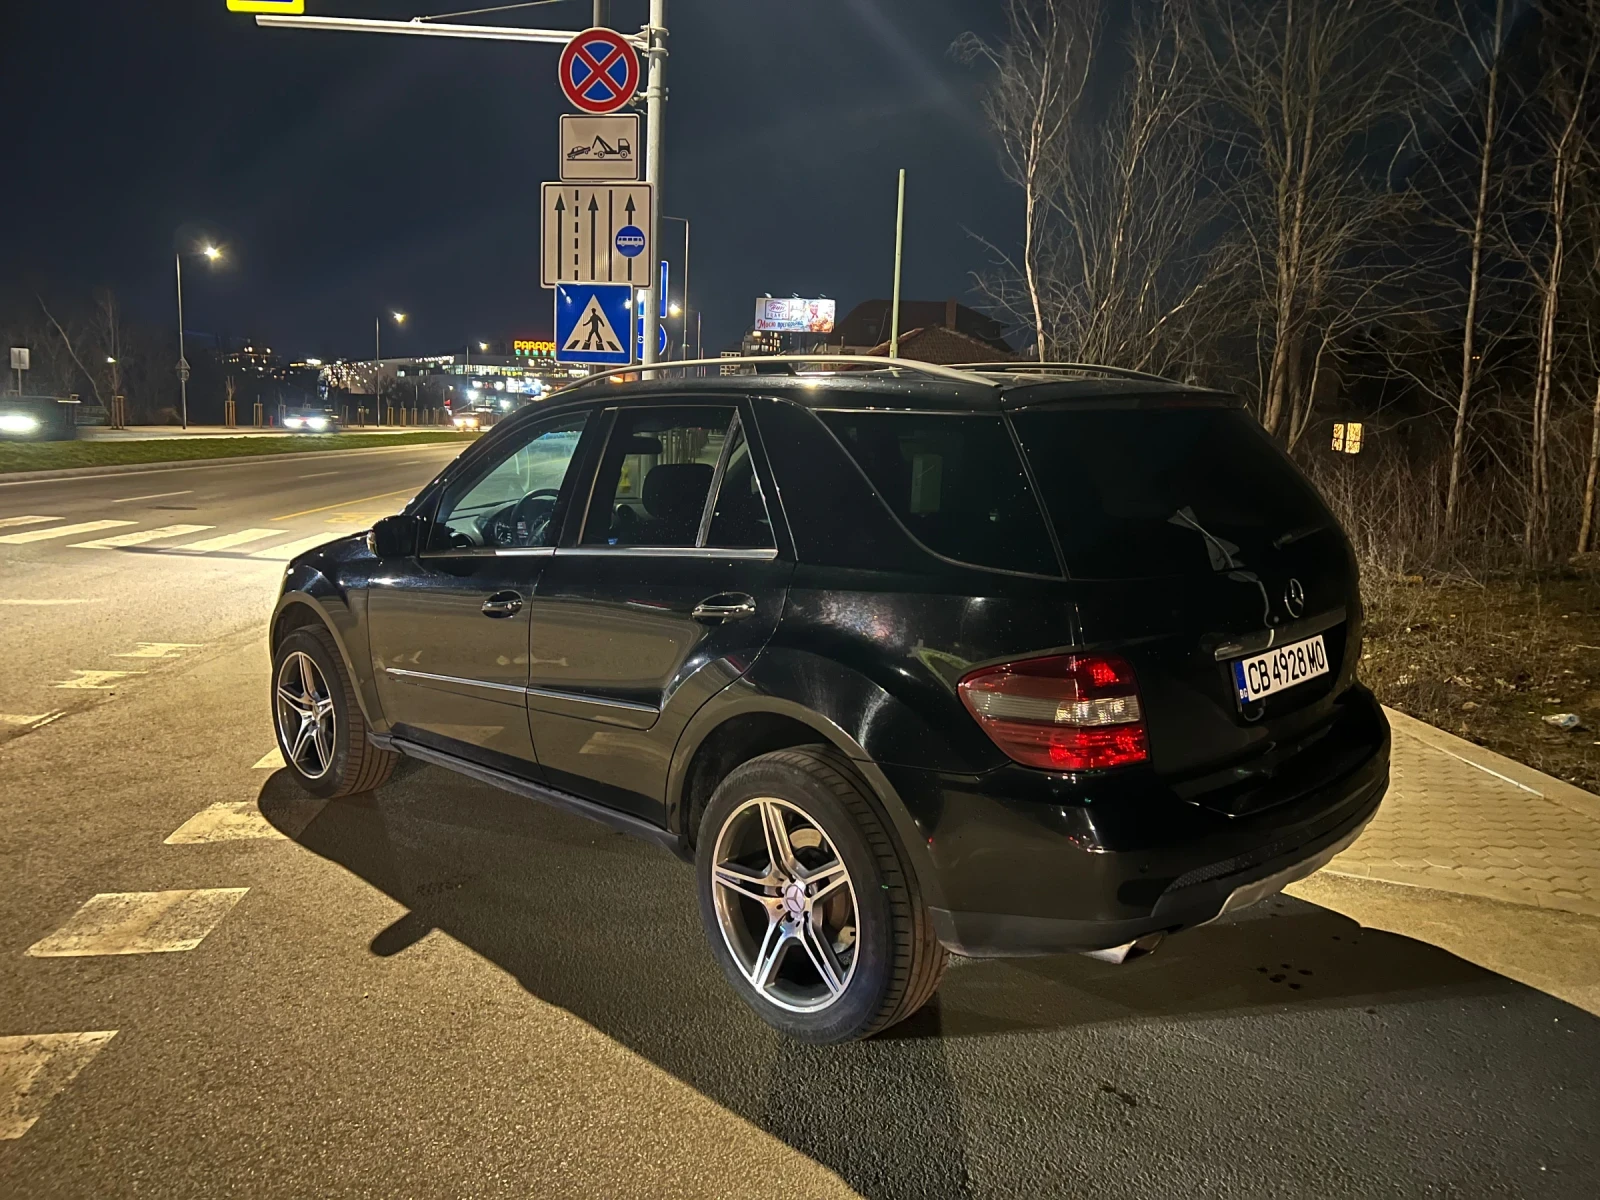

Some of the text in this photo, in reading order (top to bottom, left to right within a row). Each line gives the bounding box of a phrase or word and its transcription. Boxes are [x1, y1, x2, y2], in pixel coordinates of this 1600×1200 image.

[514, 341, 556, 350] PARADIS
[515, 349, 556, 357] CENTE
[1248, 641, 1325, 695] CB 4928 MO
[1239, 688, 1248, 699] BG
